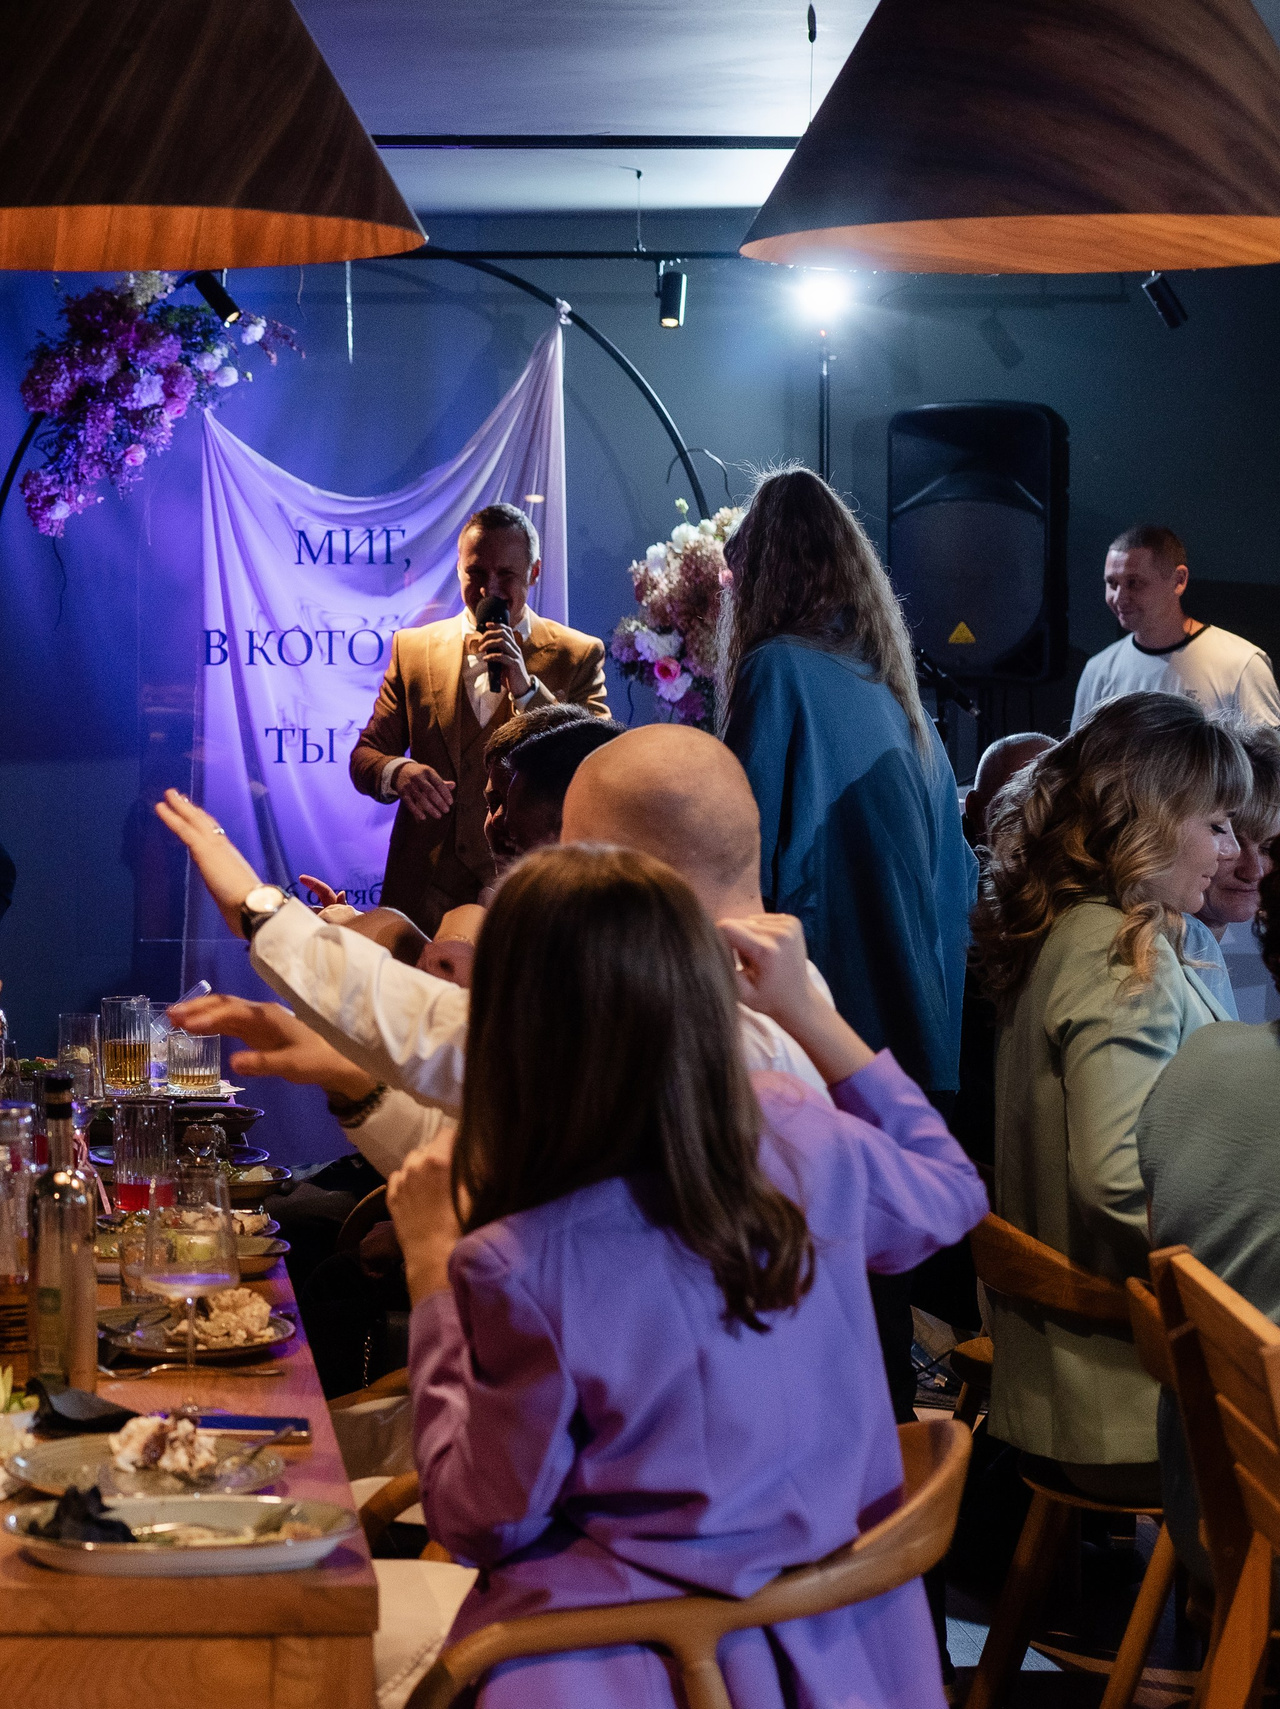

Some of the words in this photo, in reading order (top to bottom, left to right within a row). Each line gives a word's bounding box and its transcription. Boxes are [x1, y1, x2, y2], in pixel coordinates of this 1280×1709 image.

[293, 527, 412, 573] МИГ,
[203, 628, 229, 666] В
[244, 628, 396, 667] КОТО
[264, 727, 338, 764] ТЫ
